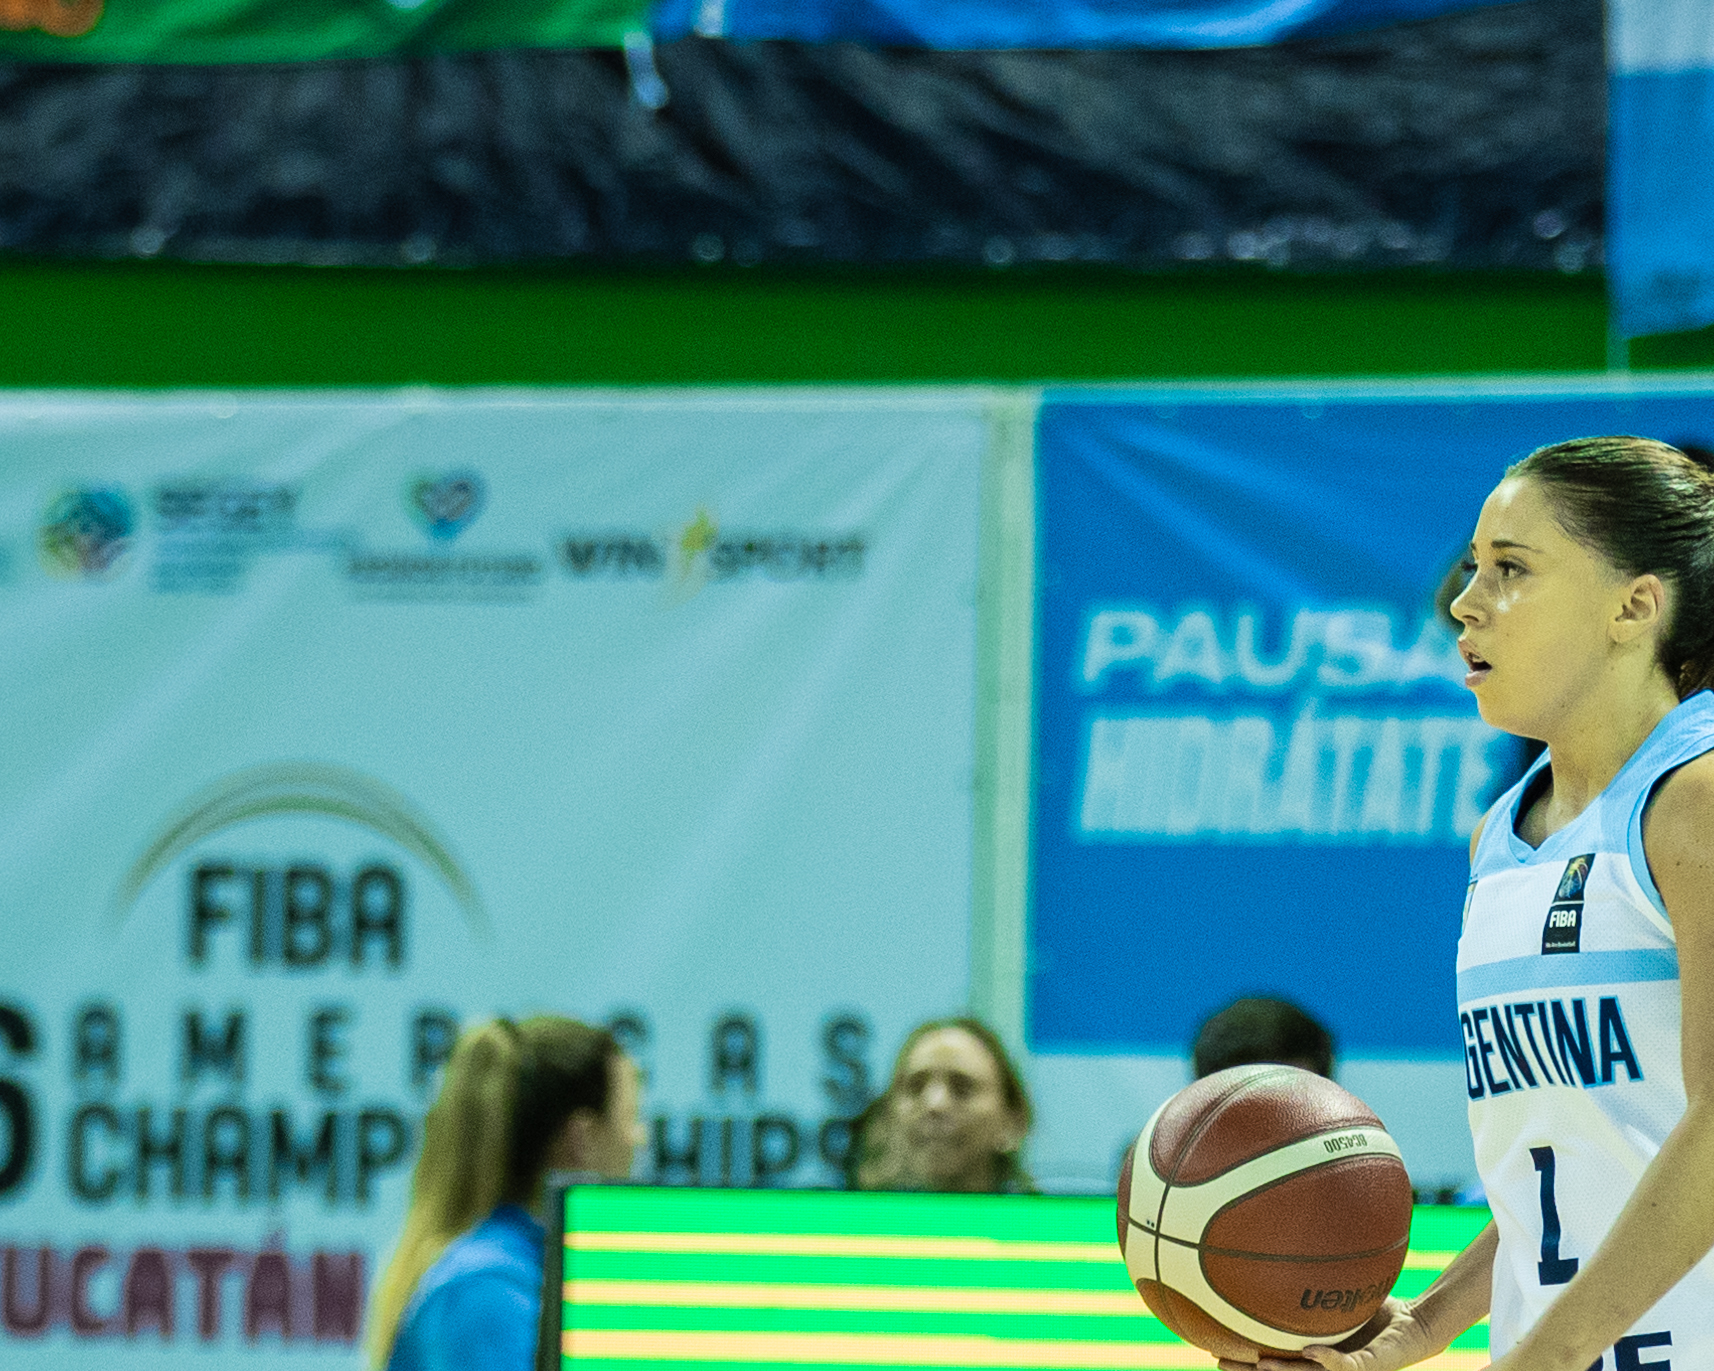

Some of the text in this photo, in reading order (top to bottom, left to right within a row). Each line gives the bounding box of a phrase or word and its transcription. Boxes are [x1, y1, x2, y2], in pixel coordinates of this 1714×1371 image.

[186, 860, 409, 968] FIBA
[1549, 909, 1577, 928] FIBA
[1323, 1133, 1368, 1154] BG4500
[1529, 1144, 1580, 1286] 1
